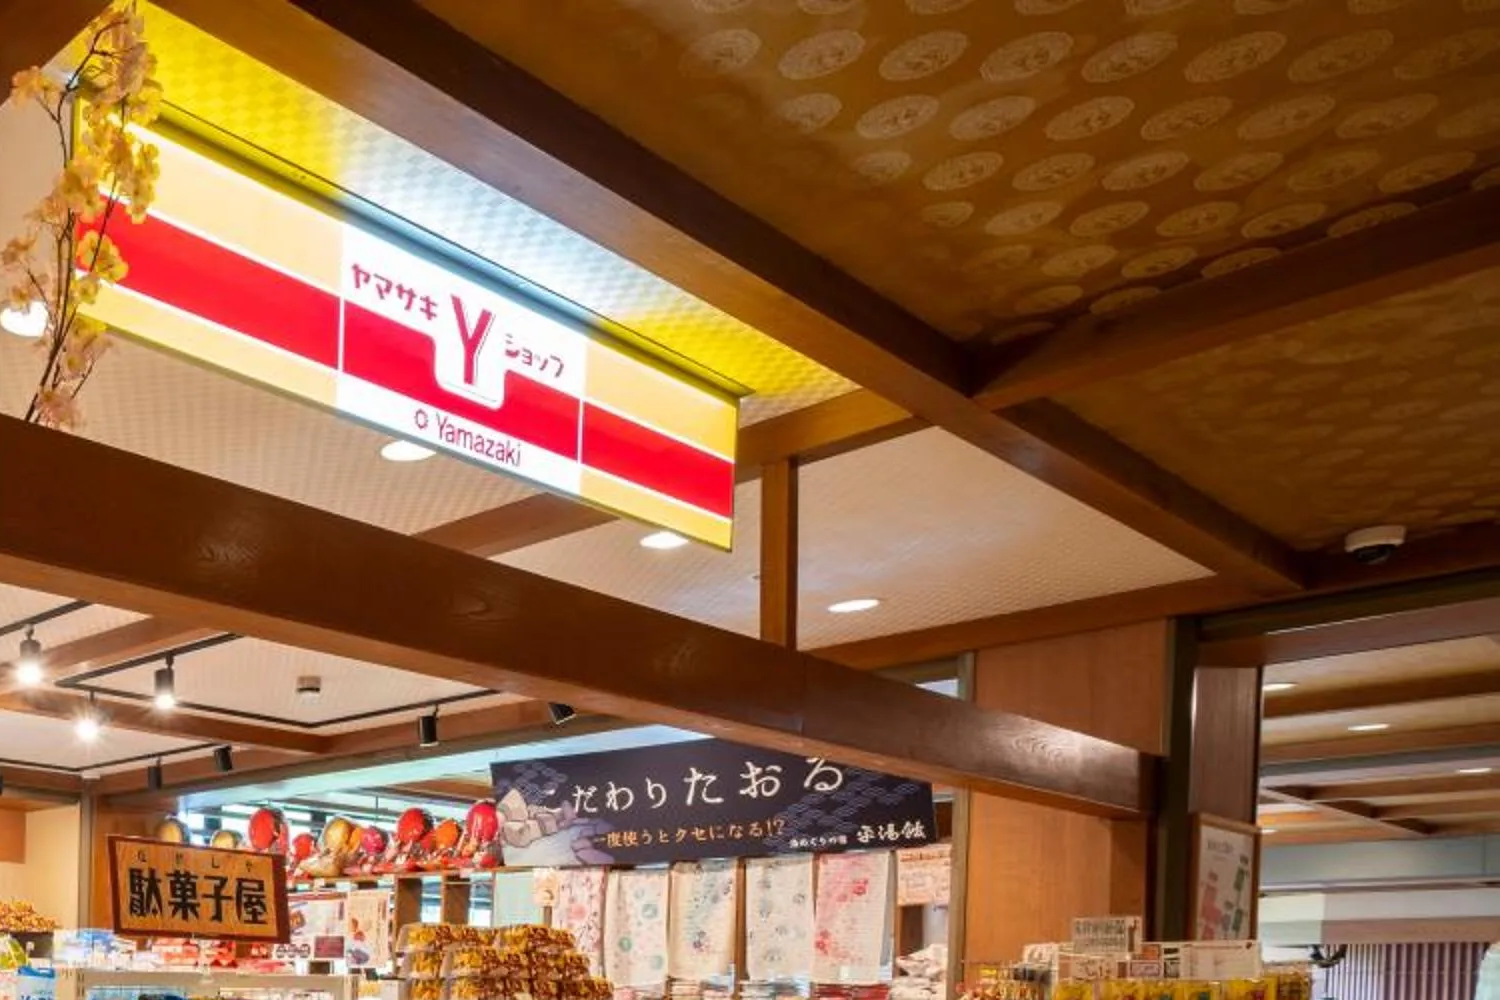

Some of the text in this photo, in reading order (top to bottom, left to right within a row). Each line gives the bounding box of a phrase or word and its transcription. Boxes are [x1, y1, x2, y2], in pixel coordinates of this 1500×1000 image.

[352, 263, 438, 321] ヤマサキ
[451, 294, 496, 385] Y
[435, 411, 521, 466] Yamazaki
[129, 868, 268, 924] 駄菓子屋
